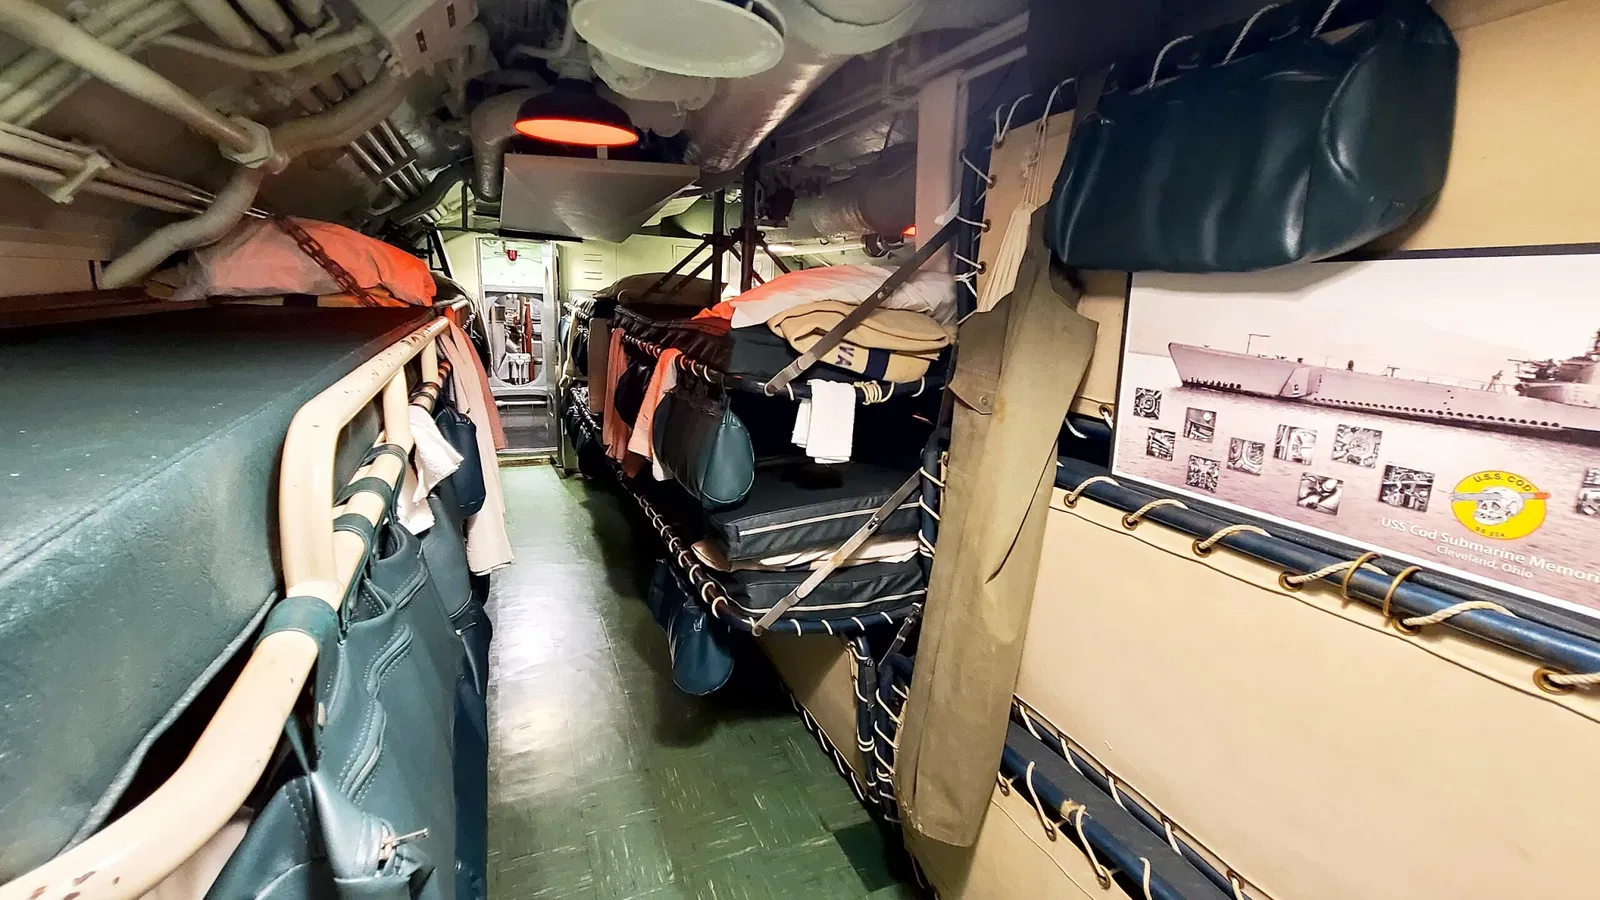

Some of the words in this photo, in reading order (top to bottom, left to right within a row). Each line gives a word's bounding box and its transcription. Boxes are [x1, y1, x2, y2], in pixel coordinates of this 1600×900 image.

[1507, 475, 1532, 492] COD
[1381, 516, 1406, 532] USS
[1410, 525, 1437, 540] Cod
[1439, 532, 1526, 564] Submarine
[1436, 545, 1499, 570] Cleveland,
[1502, 563, 1534, 578] Ohio
